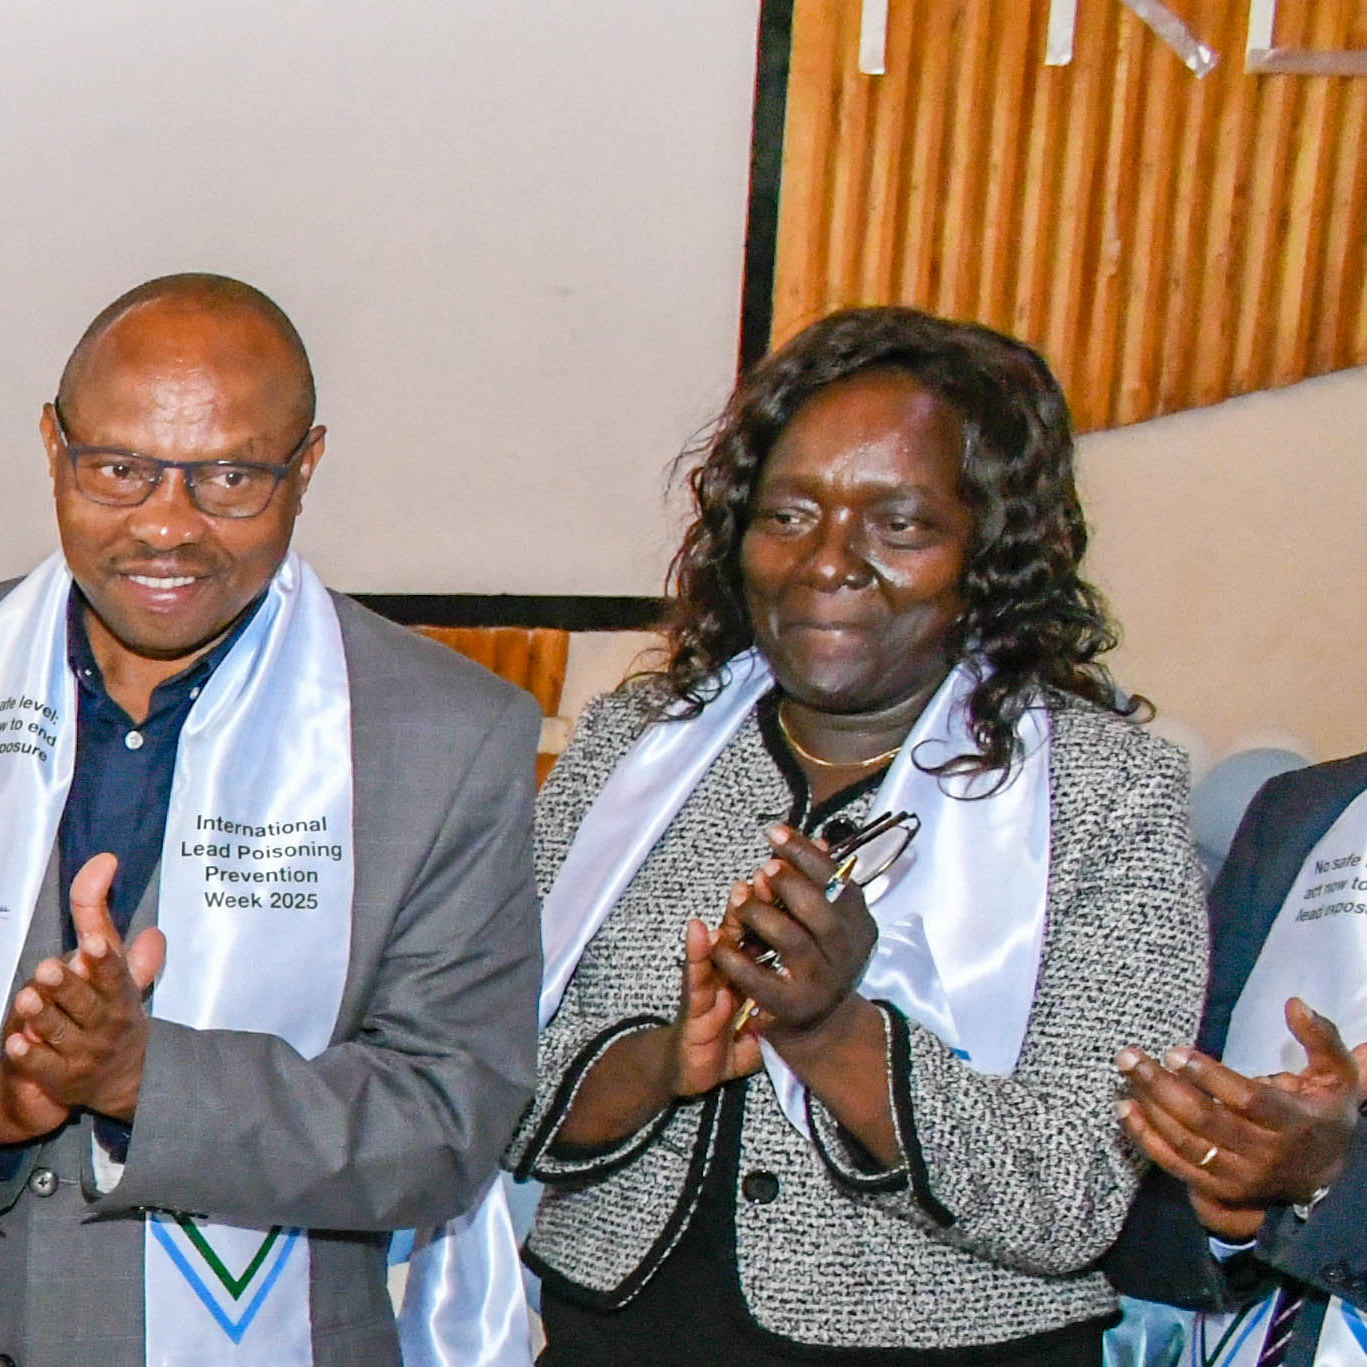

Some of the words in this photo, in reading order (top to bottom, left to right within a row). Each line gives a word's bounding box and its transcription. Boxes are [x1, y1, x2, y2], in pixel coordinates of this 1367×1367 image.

[19, 694, 59, 725] level:
[10, 718, 23, 731] to
[28, 722, 57, 747] end
[196, 814, 327, 838] International
[180, 841, 231, 858] Lead
[237, 841, 343, 861] Poisoning
[204, 865, 319, 883] Prevention
[1314, 860, 1330, 875] No
[1352, 877, 1367, 892] to
[204, 891, 263, 908] Week
[269, 892, 318, 910] 2025
[1295, 907, 1323, 922] lead
